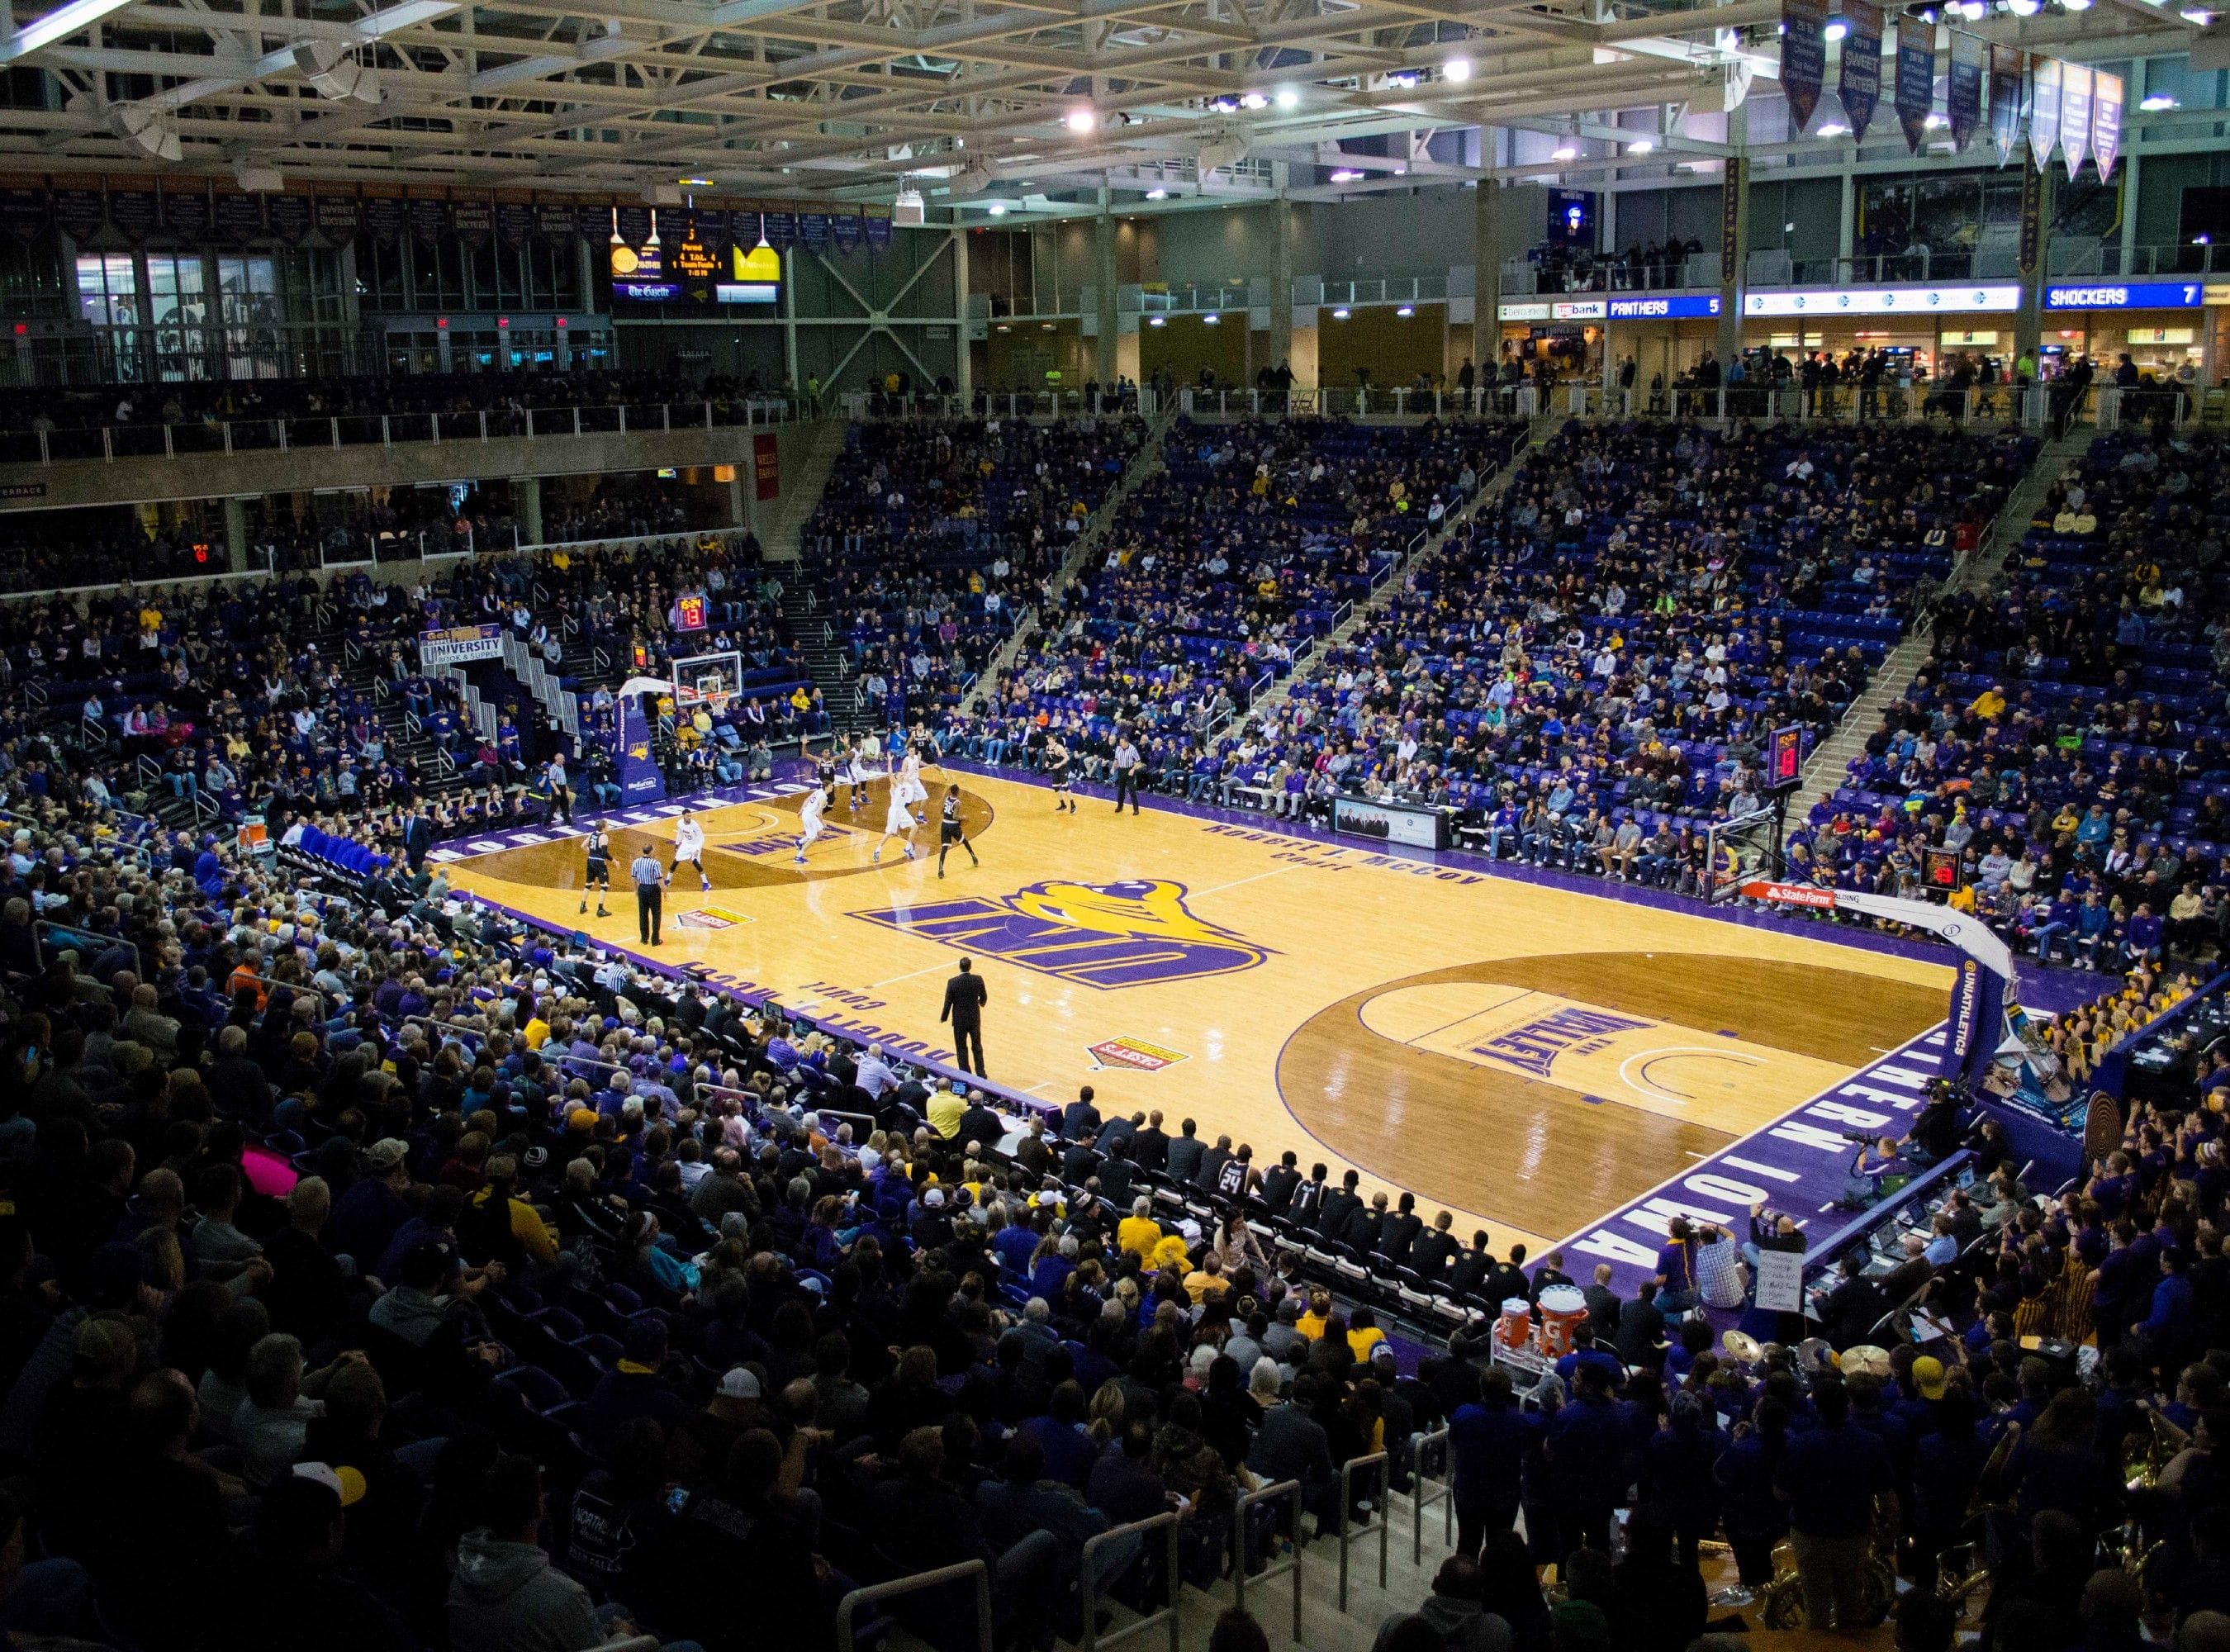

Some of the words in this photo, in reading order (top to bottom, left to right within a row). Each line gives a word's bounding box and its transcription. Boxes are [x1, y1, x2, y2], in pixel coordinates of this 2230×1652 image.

[1844, 50, 1879, 72] SWEET
[1844, 71, 1878, 94] SIXTEEN
[319, 206, 356, 215] SWEET
[455, 209, 490, 219] SWEET
[540, 211, 572, 221] SWEET
[319, 216, 357, 226] SIXTEEN
[455, 220, 491, 230] SIXTEEN
[540, 222, 574, 233] SIXTEEN
[628, 285, 644, 297] The
[644, 285, 671, 297] Gazette
[2050, 287, 2128, 306] SHOCKERS
[2183, 287, 2196, 304] 7
[1611, 300, 1669, 317] PANTHERS
[1709, 299, 1719, 313] 5
[757, 453, 777, 465] WELLS
[0, 487, 42, 496] ERRACE
[686, 609, 700, 626] 13
[426, 629, 450, 641] Get
[423, 638, 500, 664] UNIVERSITY
[470, 650, 500, 659] SUPPLY
[1834, 893, 1860, 904] ALDING
[1953, 960, 1976, 1056] @UNIATHLETICS
[1468, 1007, 1658, 1078] VALLEY
[1572, 1037, 1616, 1056] THE
[1099, 1043, 1164, 1066] CASEY'S
[1219, 1172, 1242, 1194] 24
[1300, 1192, 1310, 1208] 1
[1503, 1316, 1511, 1327] G
[1544, 1320, 1560, 1339] G
